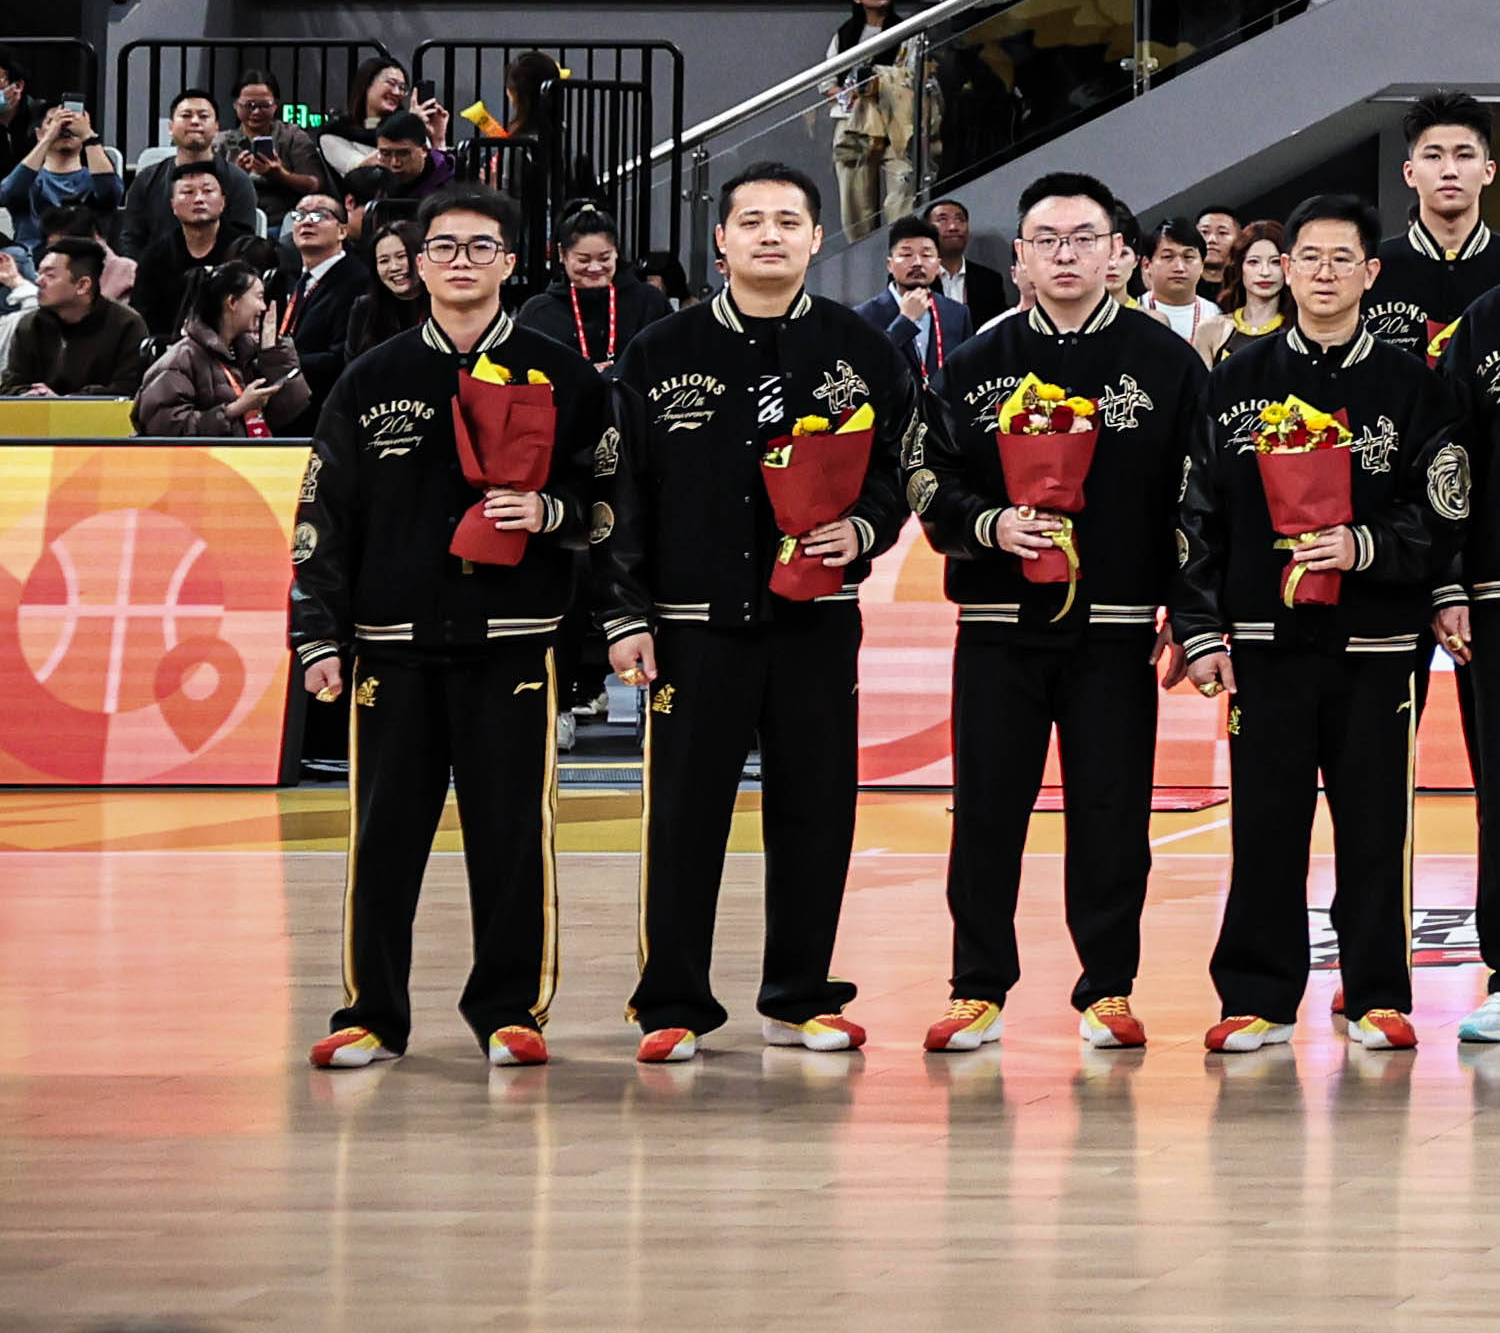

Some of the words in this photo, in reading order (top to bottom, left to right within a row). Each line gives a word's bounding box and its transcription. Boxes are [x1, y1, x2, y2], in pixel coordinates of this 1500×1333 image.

[1366, 301, 1427, 326] JLIONS
[648, 373, 726, 402] ZJLIONS
[360, 399, 435, 428] ZJLIONS
